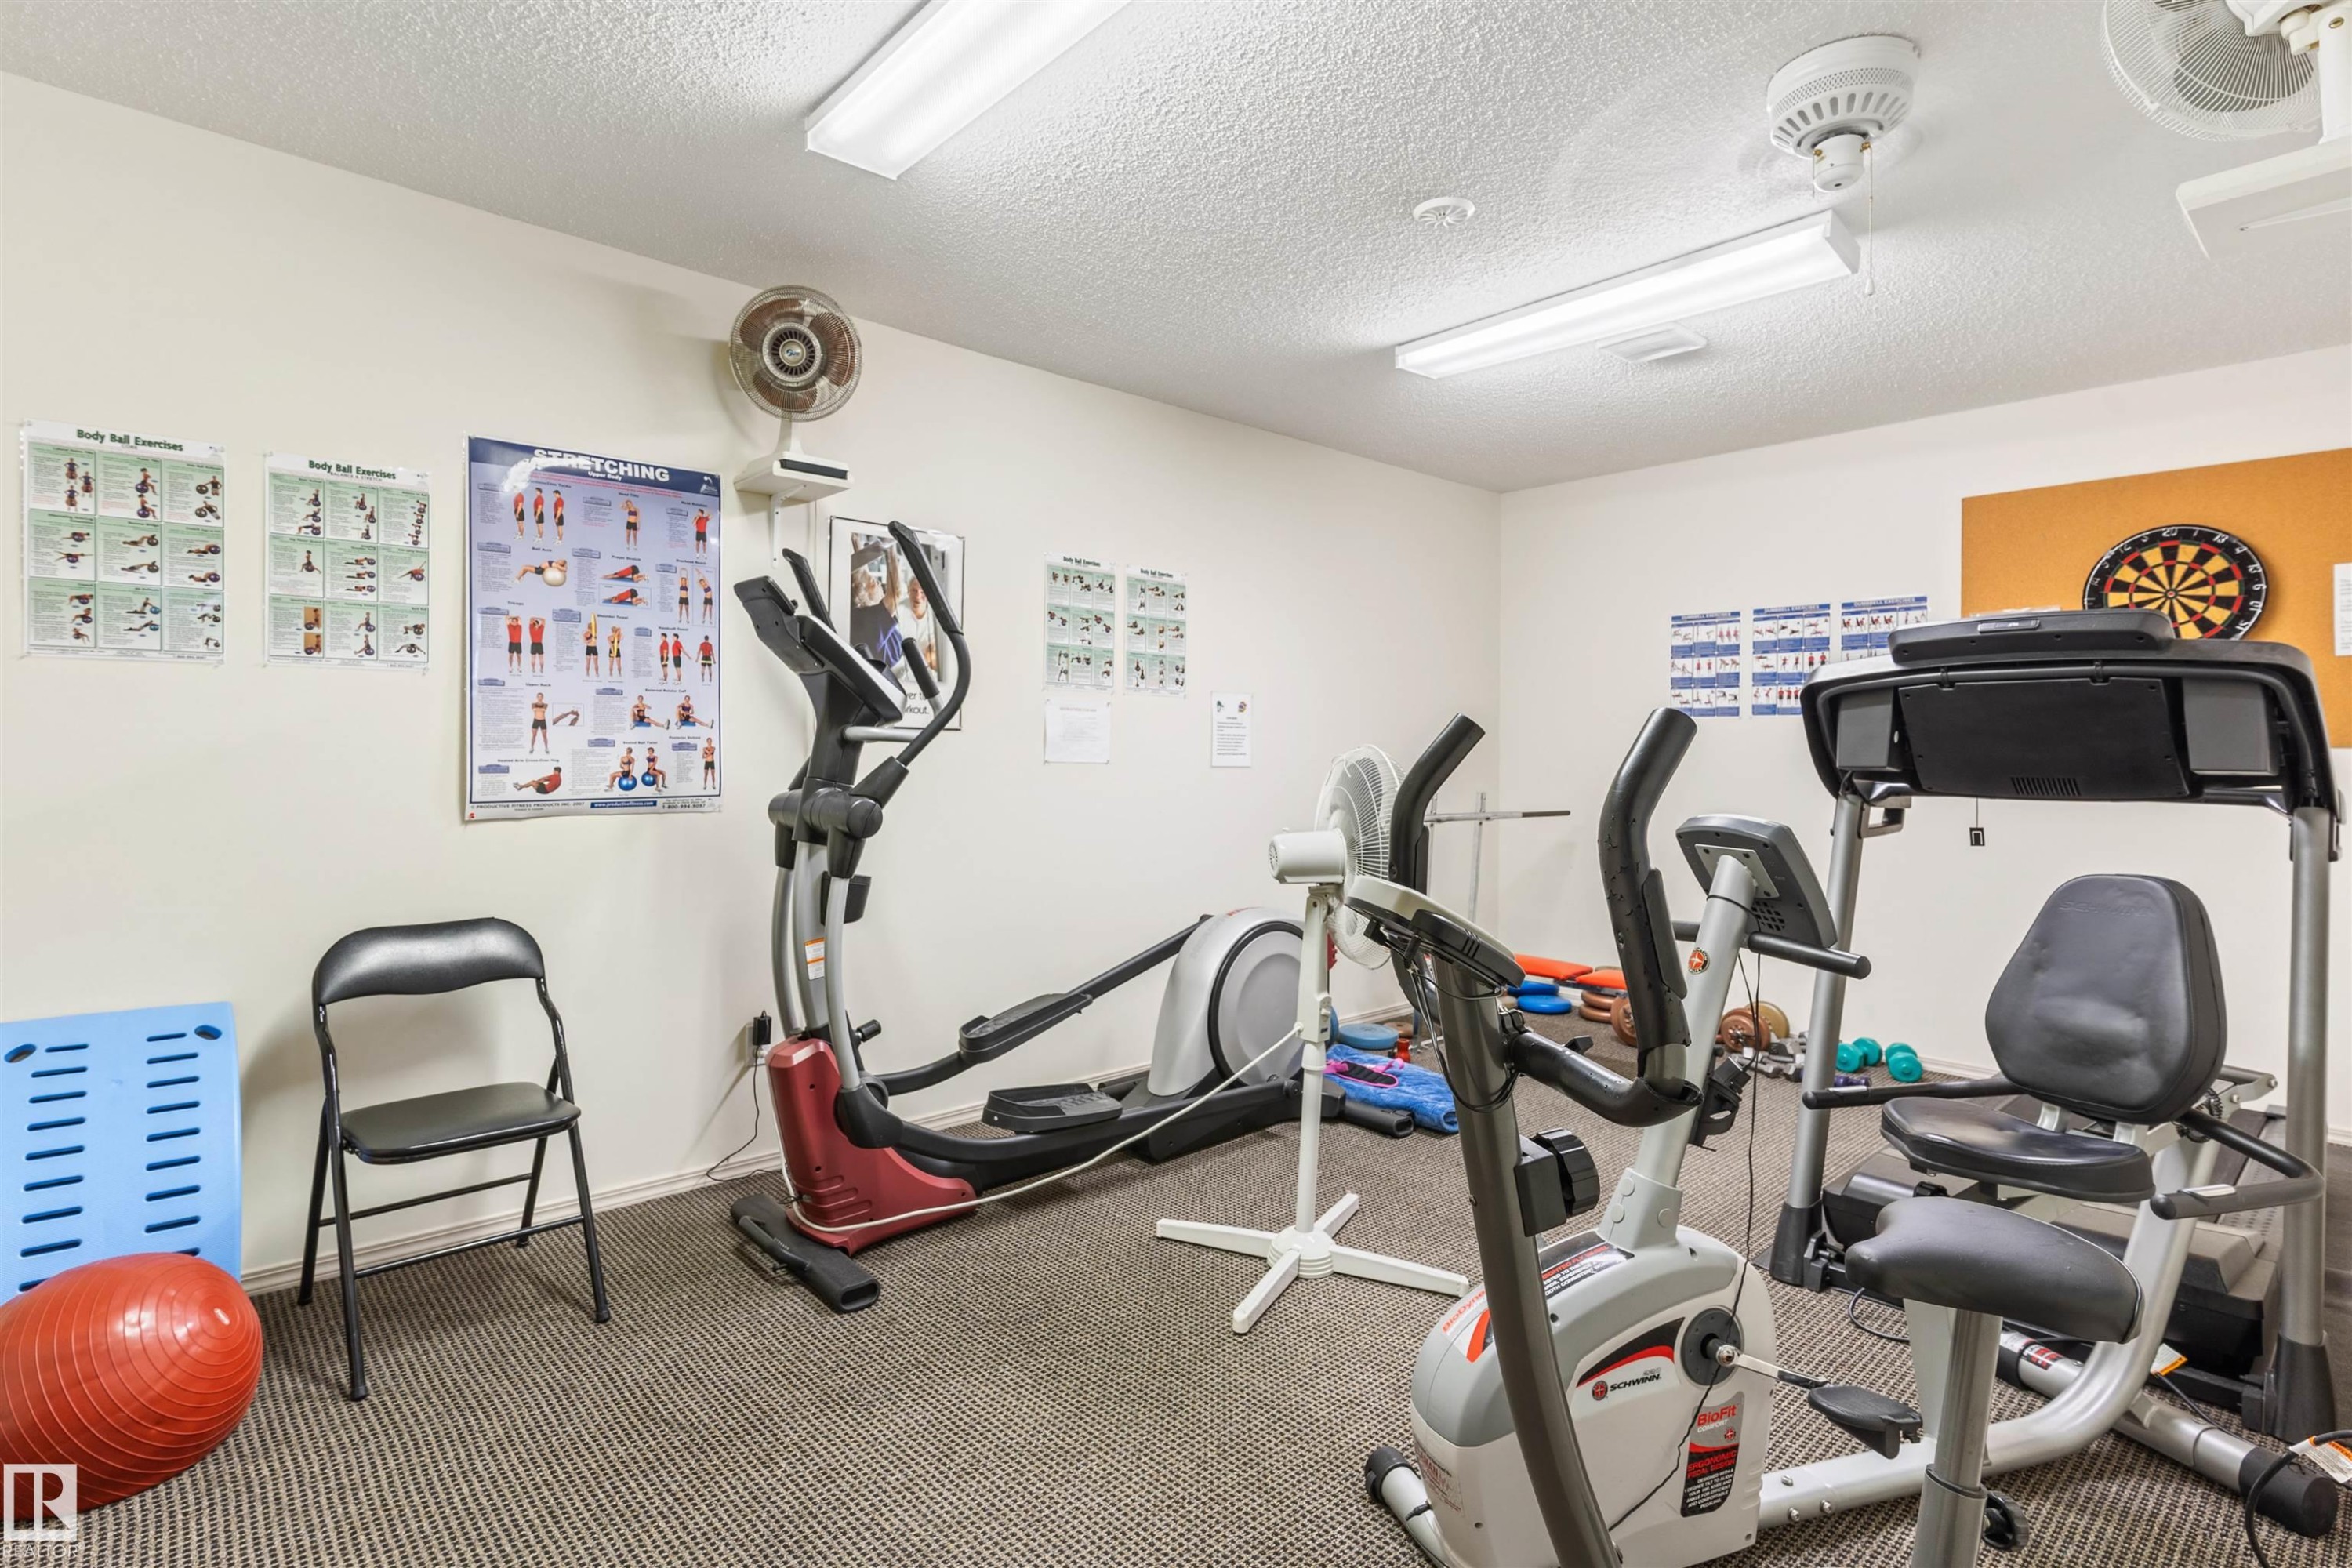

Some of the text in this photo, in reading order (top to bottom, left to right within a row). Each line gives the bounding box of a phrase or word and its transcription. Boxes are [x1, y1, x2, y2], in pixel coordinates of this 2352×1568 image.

[77, 429, 183, 452] Body Ball Exercises
[308, 459, 397, 480] Body Ball Exercises
[587, 470, 606, 479] Upper
[2161, 528, 2179, 537] 20
[1062, 556, 1073, 564] Body
[904, 705, 930, 714] rkout.
[1610, 1374, 1661, 1392] SCHWINN
[1697, 1405, 1737, 1426] BioFit
[1697, 1419, 1728, 1433] COMFORT
[1688, 1450, 1737, 1472] ERGONOMIC
[1688, 1459, 1735, 1479] PEDAL DESIGN
